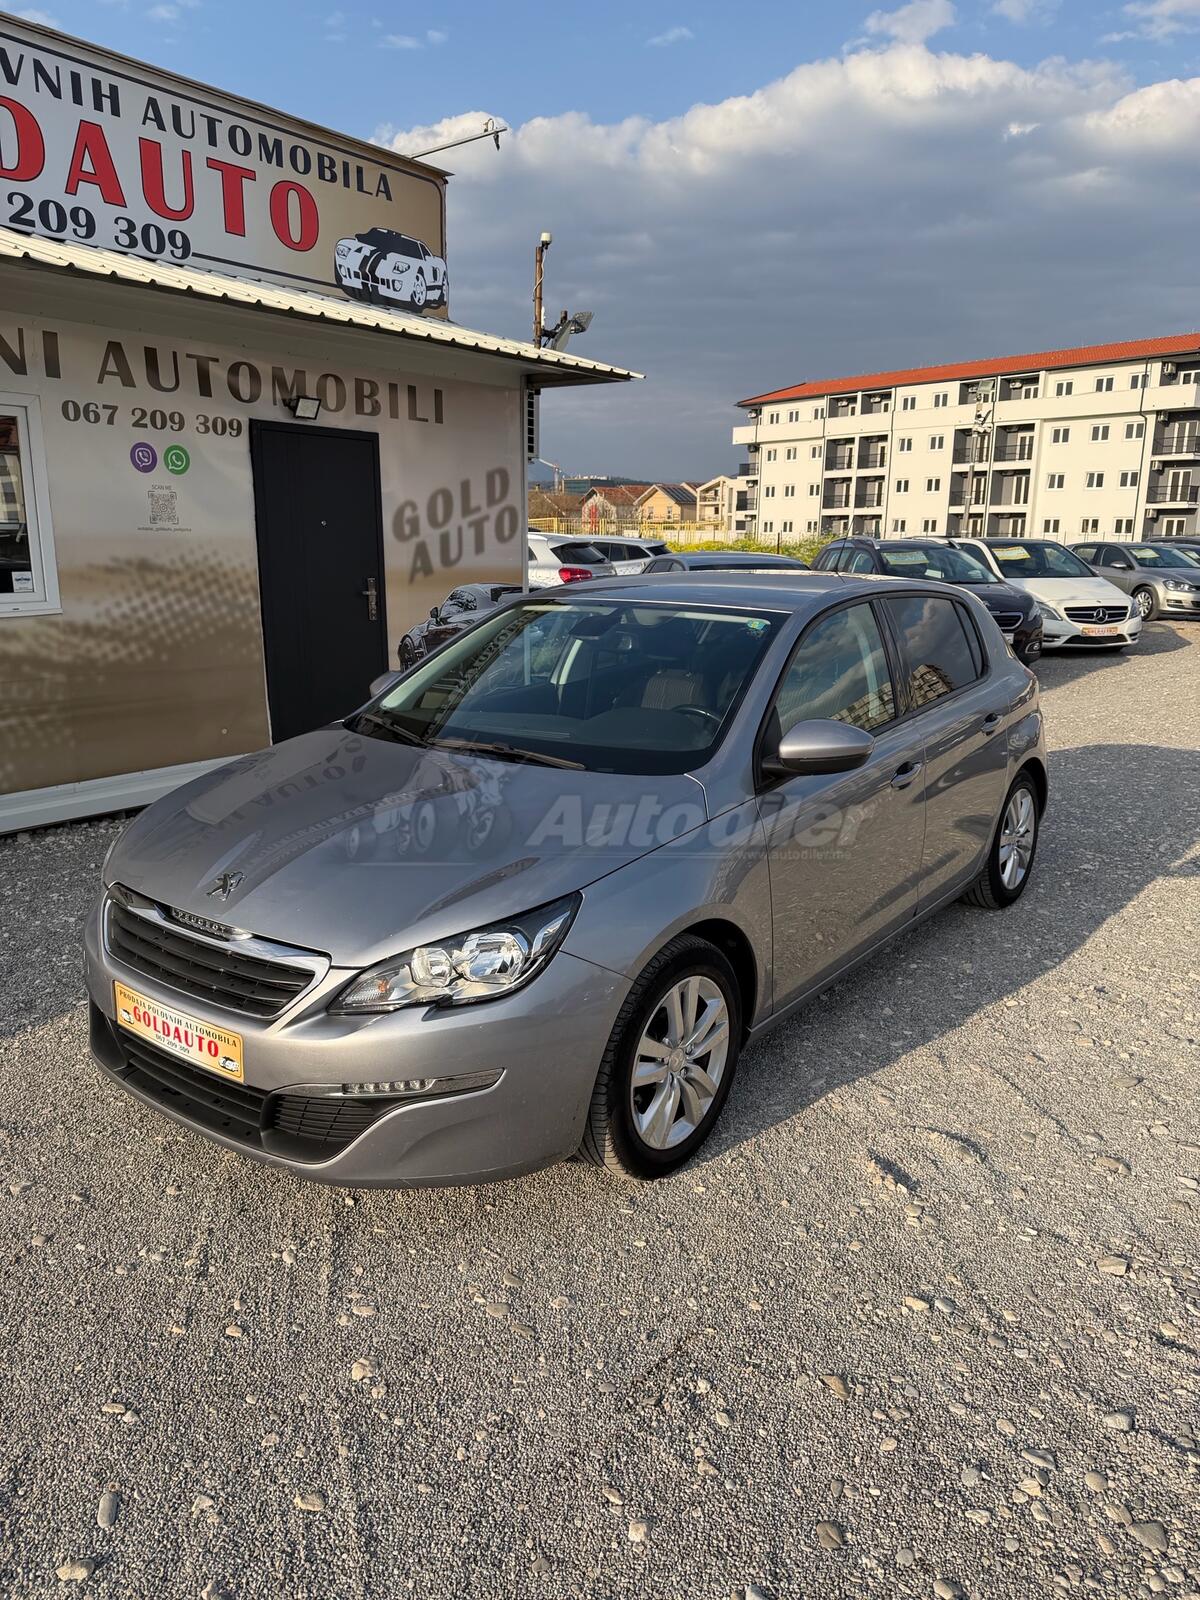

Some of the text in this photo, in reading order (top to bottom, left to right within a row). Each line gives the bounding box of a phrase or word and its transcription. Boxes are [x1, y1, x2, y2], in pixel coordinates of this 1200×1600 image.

[141, 95, 393, 202] AUTOMOBILA
[7, 191, 192, 260] 209 309
[61, 399, 243, 438] 067 209 309
[97, 340, 445, 425] AUTOMOBILI
[392, 466, 510, 543] GOLD
[408, 504, 519, 584] AUTO
[119, 989, 237, 1048] PRODAJA POLOVNIH AUTOMOBILA
[133, 1006, 219, 1058] GOLDAUTO
